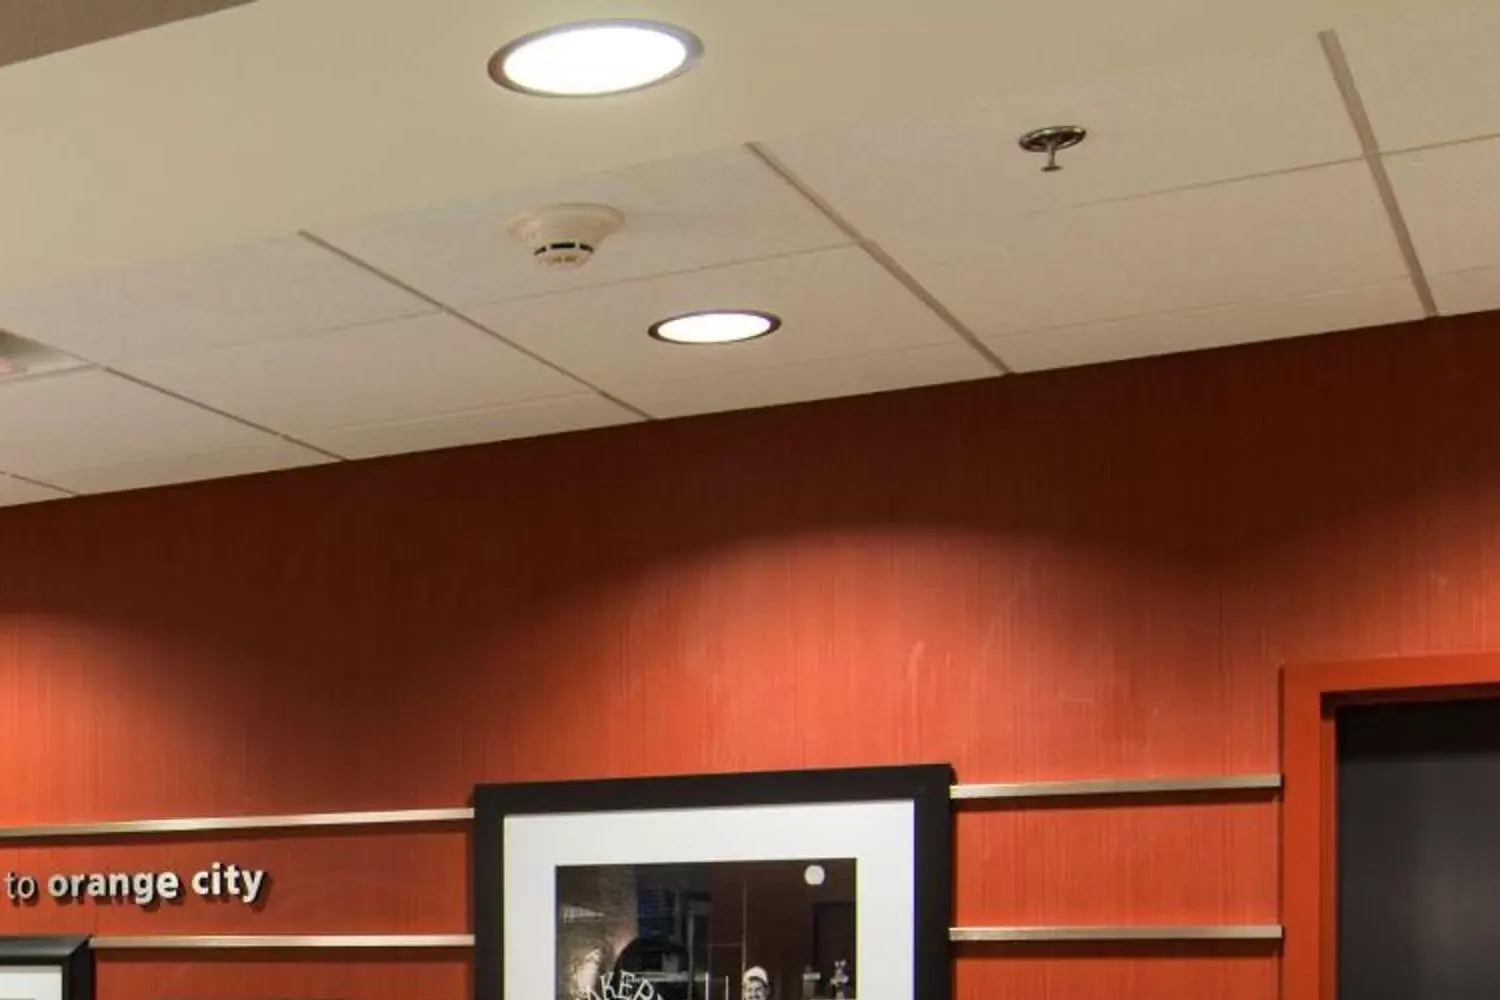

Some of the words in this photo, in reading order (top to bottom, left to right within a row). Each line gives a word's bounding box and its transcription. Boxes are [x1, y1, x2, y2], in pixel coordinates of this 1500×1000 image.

[4, 872, 36, 900] to
[47, 867, 179, 905] orange
[191, 862, 263, 903] city
